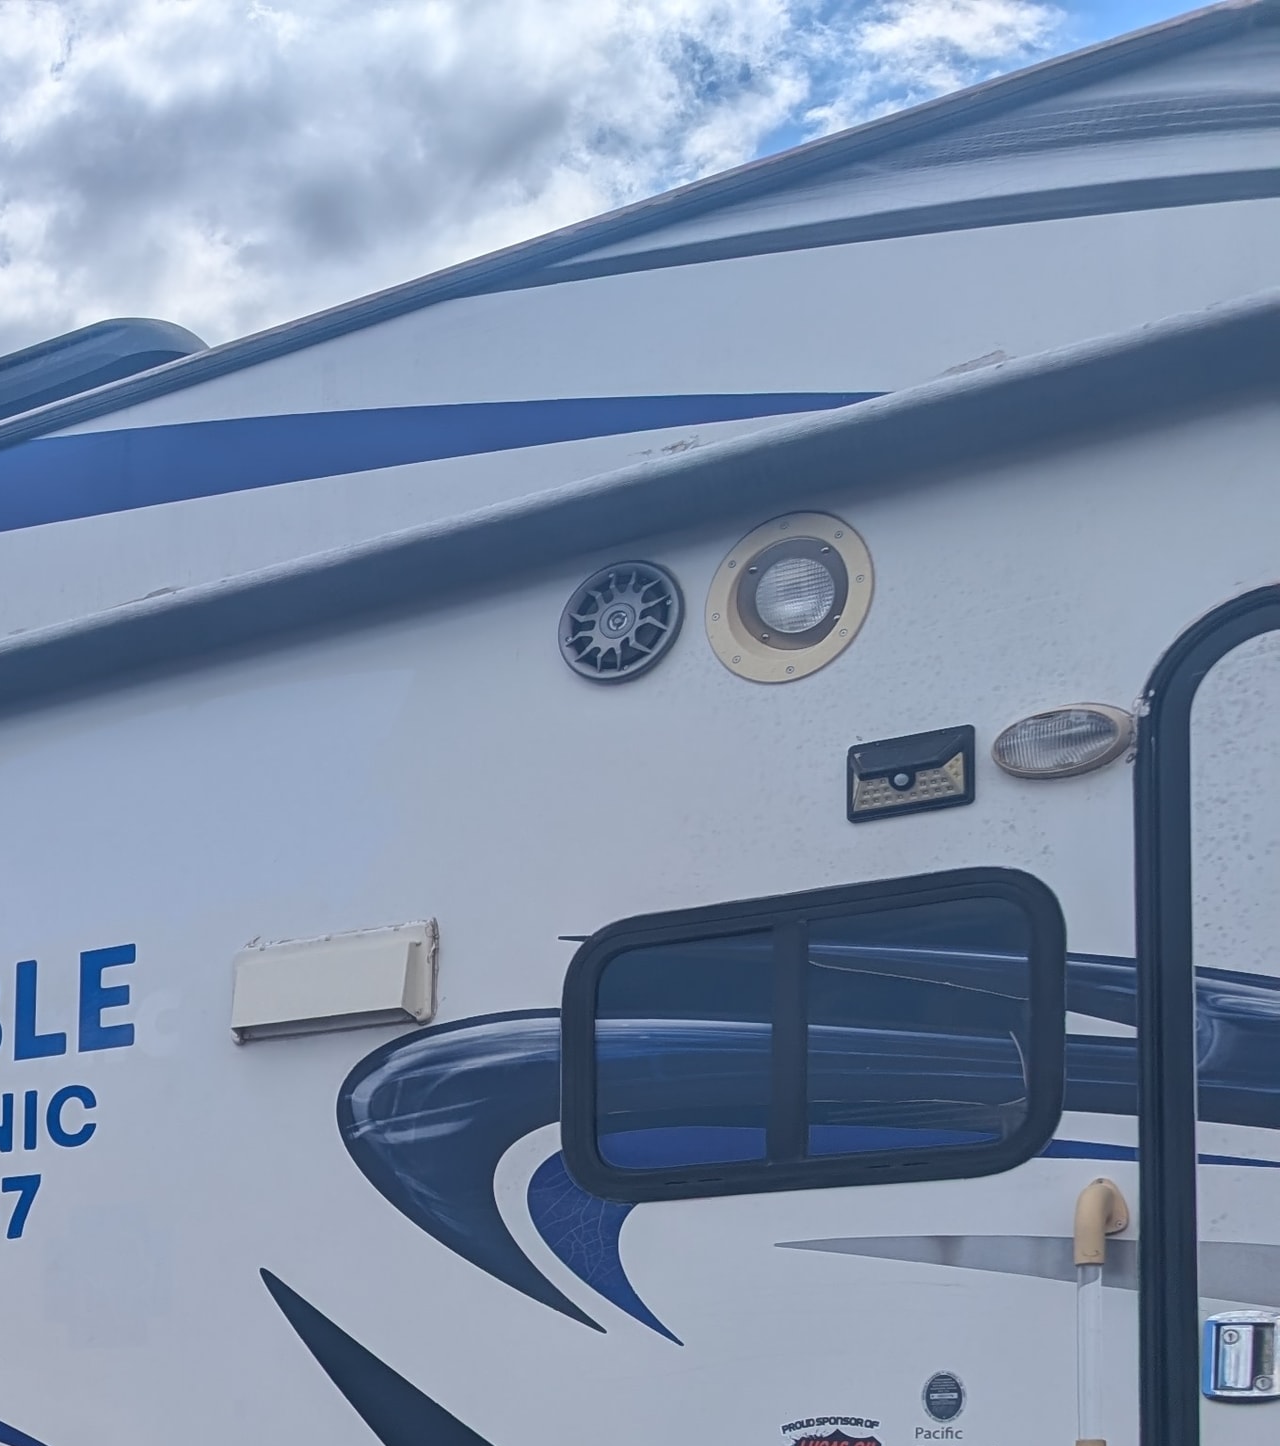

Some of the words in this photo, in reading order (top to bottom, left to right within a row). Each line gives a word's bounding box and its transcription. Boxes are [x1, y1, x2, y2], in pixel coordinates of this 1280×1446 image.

[781, 1418, 815, 1434] PROUD
[815, 1416, 864, 1426] SPONSOR
[864, 1419, 880, 1429] OF
[914, 1427, 963, 1440] Pacific
